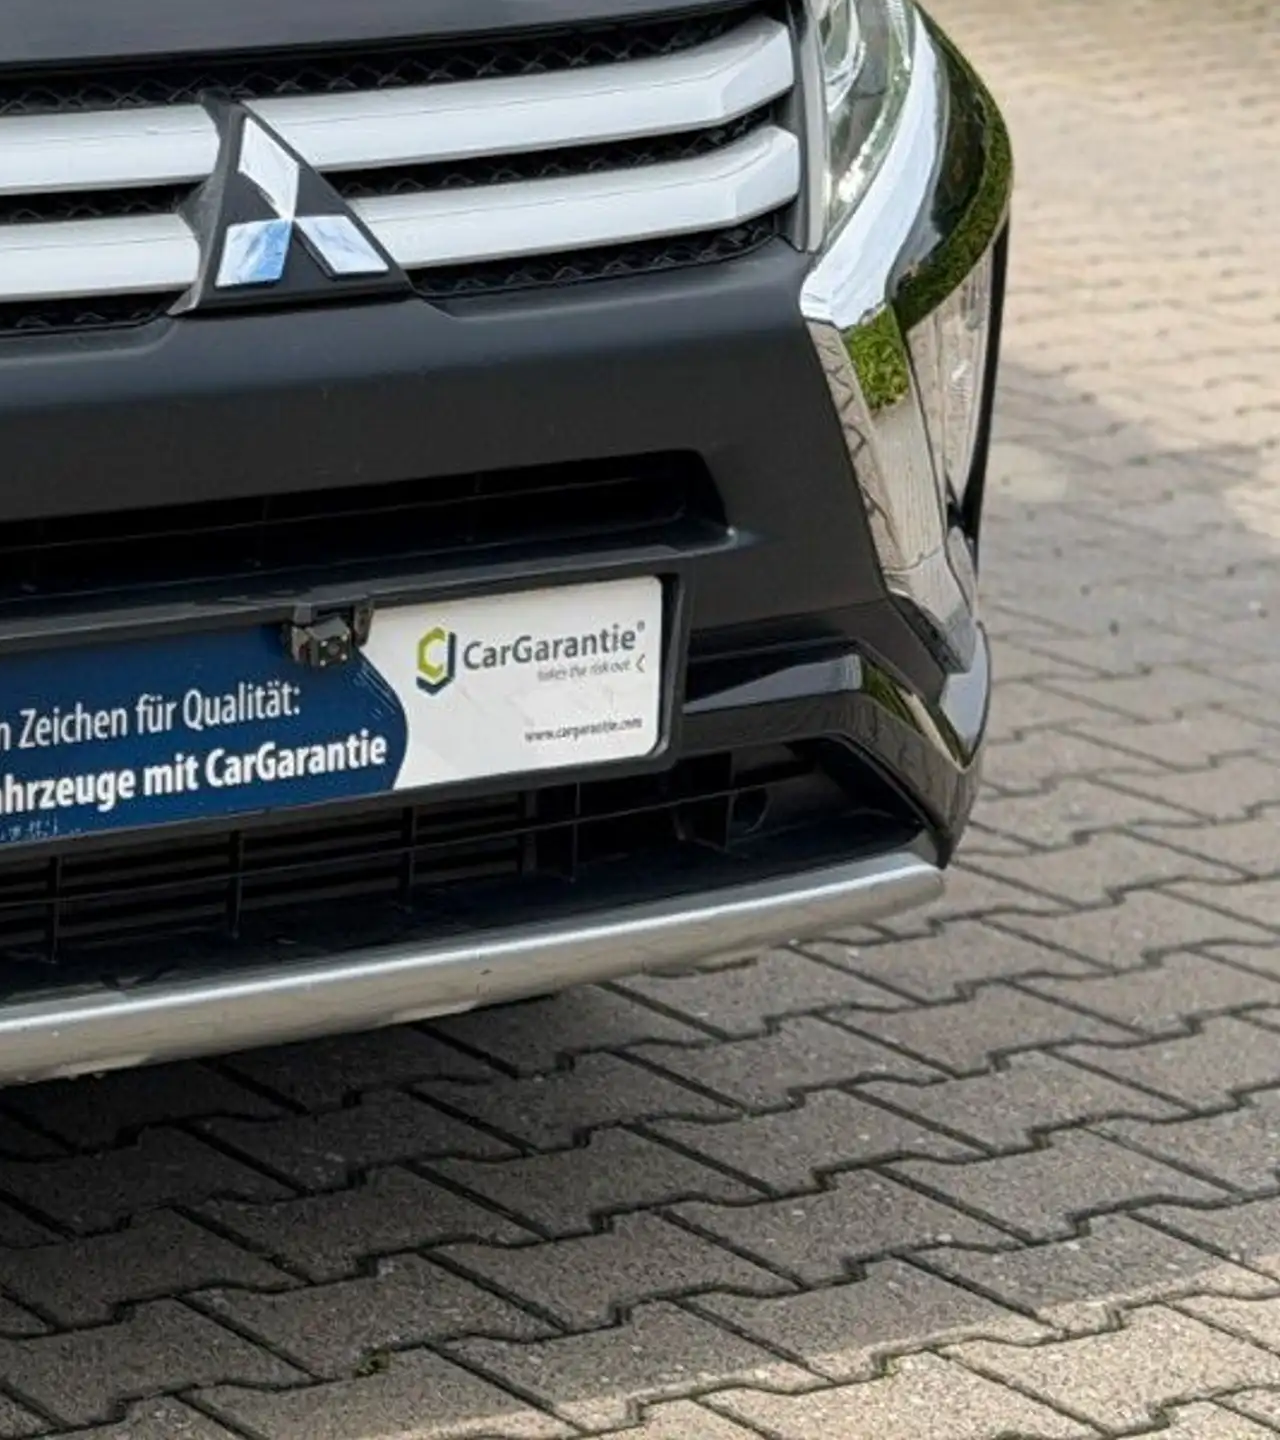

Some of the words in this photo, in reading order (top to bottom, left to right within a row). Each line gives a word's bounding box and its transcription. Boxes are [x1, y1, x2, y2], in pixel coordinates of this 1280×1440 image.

[18, 701, 128, 749] Zeichen
[135, 693, 177, 735] für
[182, 678, 301, 731] Qualität:
[144, 751, 199, 797] mit
[205, 727, 387, 787] CarGarantie
